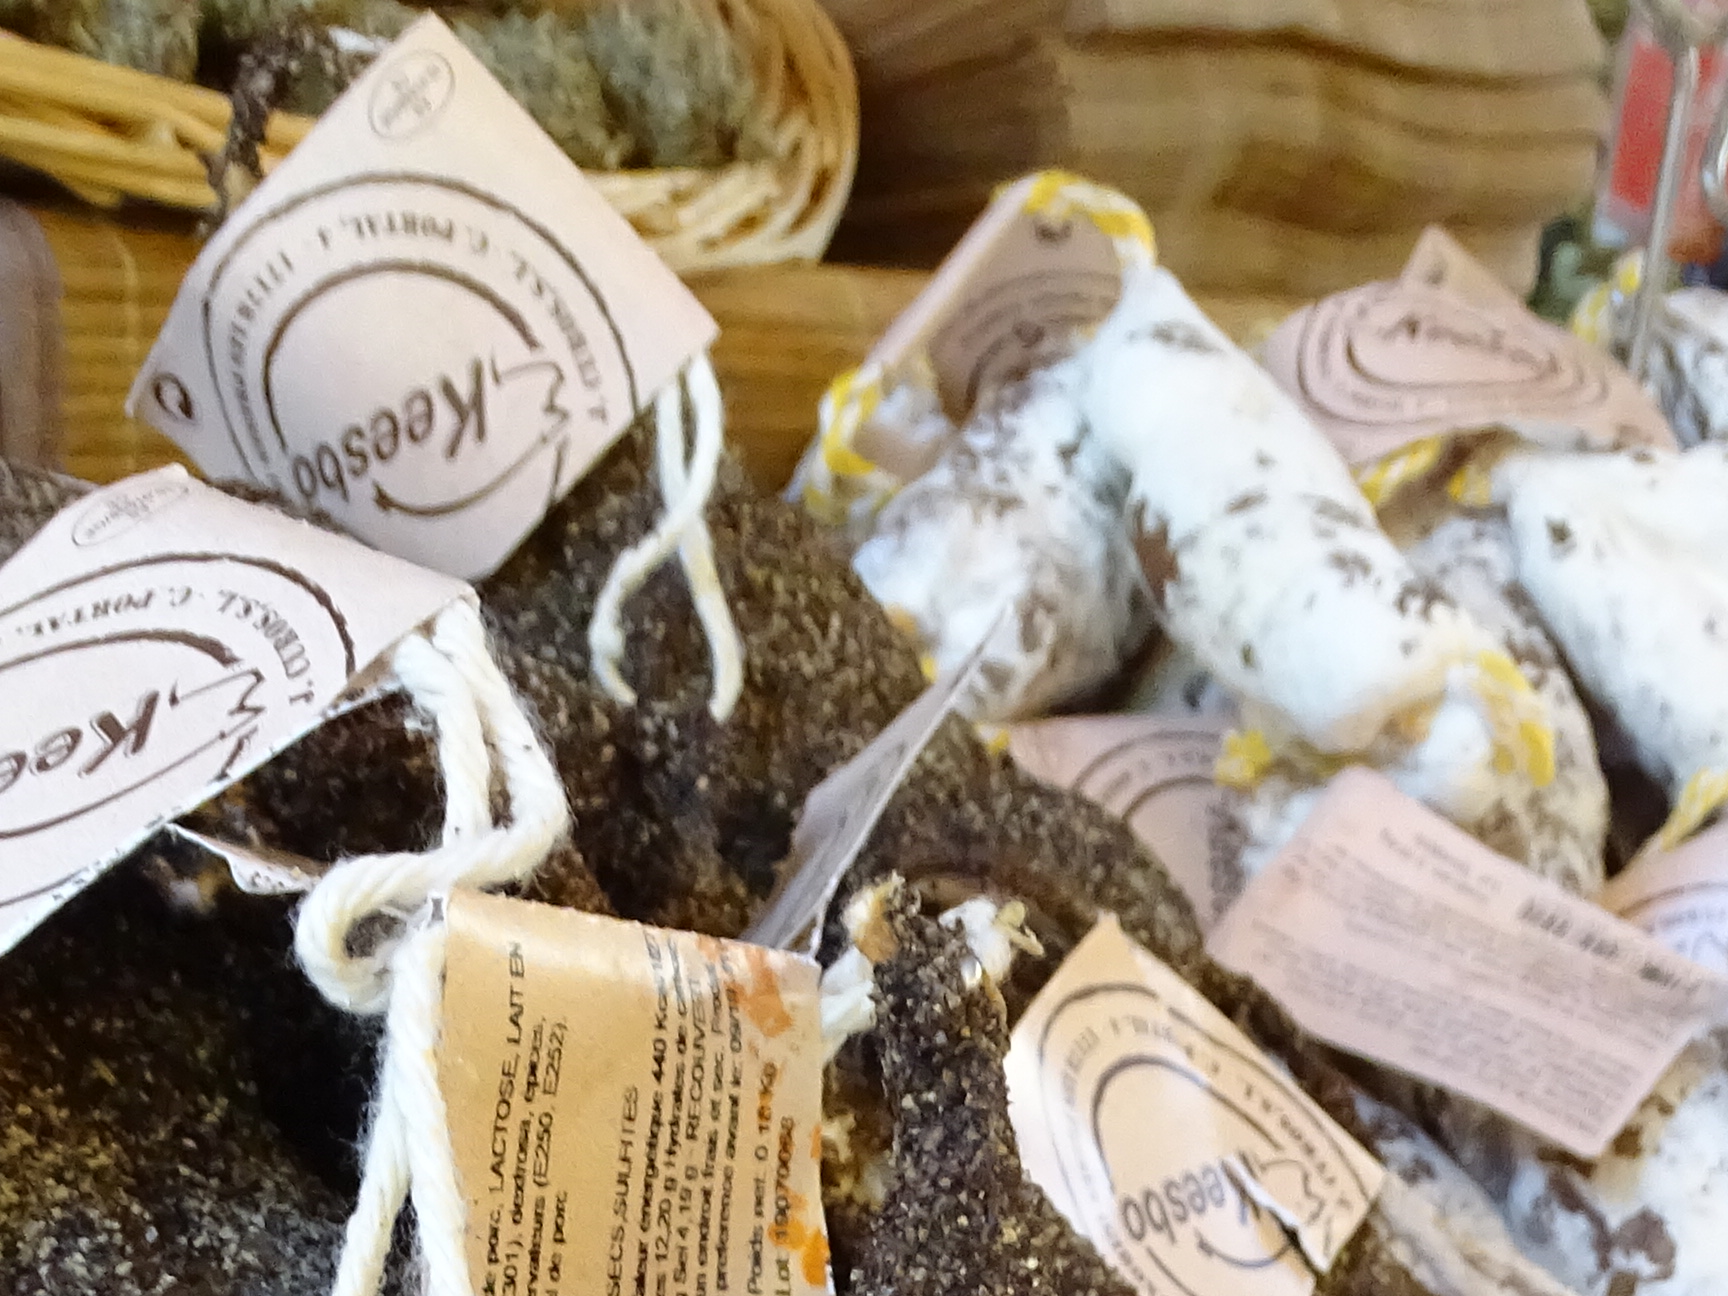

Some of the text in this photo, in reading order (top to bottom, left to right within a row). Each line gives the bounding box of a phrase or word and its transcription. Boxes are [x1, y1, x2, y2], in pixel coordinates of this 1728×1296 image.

[290, 357, 488, 502] Keesbo
[504, 986, 524, 1045] LAIT
[650, 1037, 668, 1083] 440
[661, 1177, 678, 1192] g
[670, 1025, 689, 1055] de
[745, 1225, 765, 1295] Poids
